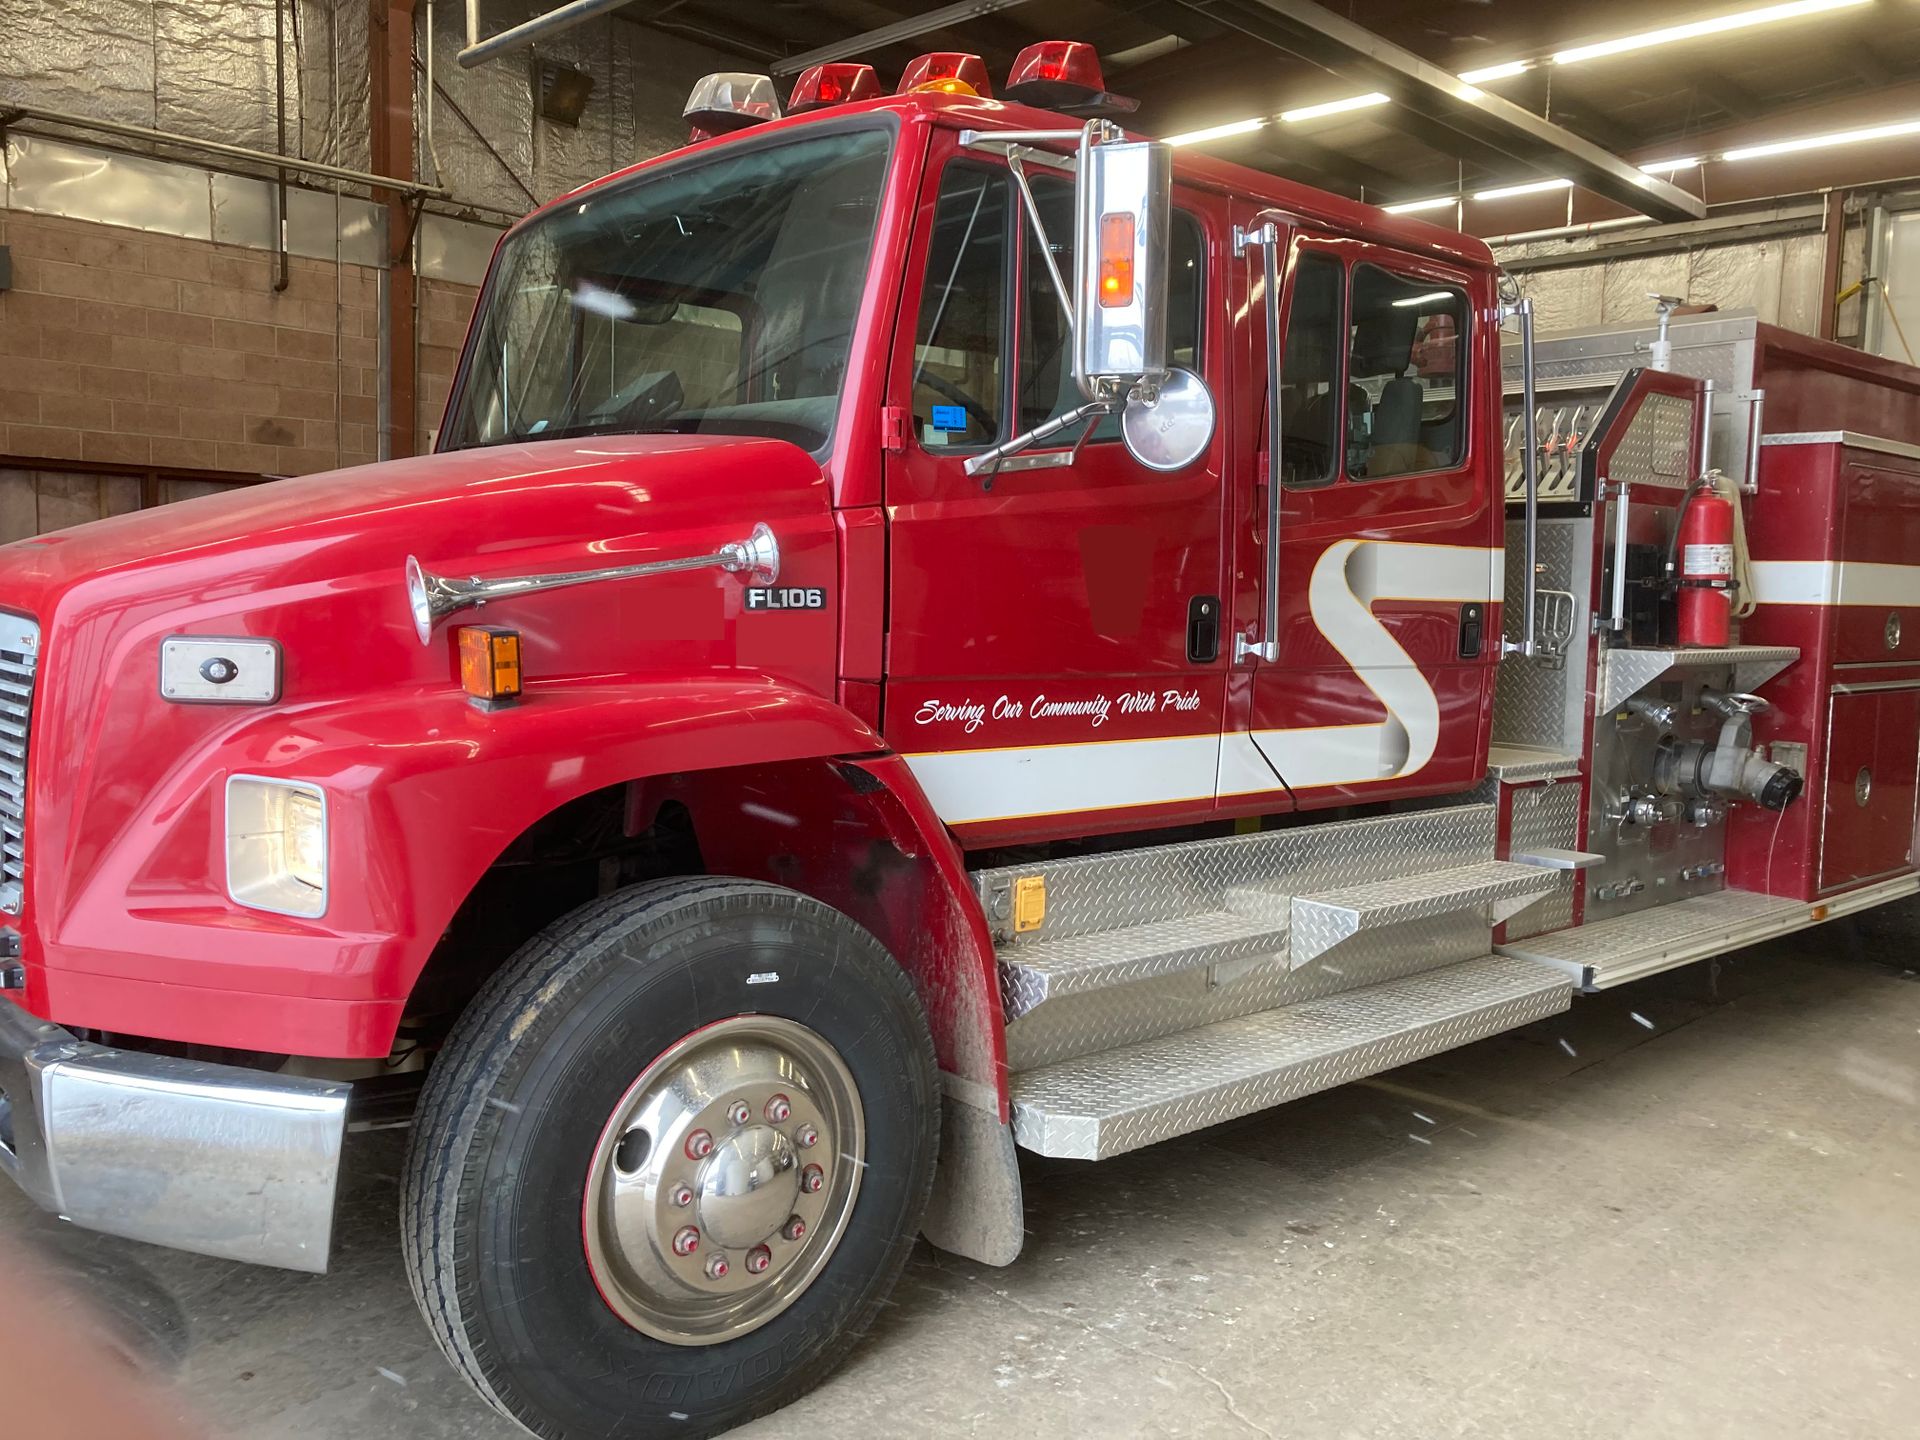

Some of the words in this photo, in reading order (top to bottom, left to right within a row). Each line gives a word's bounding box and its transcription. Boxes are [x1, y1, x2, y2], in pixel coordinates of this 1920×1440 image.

[748, 588, 822, 608] FL106
[914, 697, 986, 734] Serving
[991, 694, 1024, 720] Our
[1029, 693, 1112, 728] Community
[1116, 690, 1156, 714] With
[1160, 689, 1201, 713] Pride
